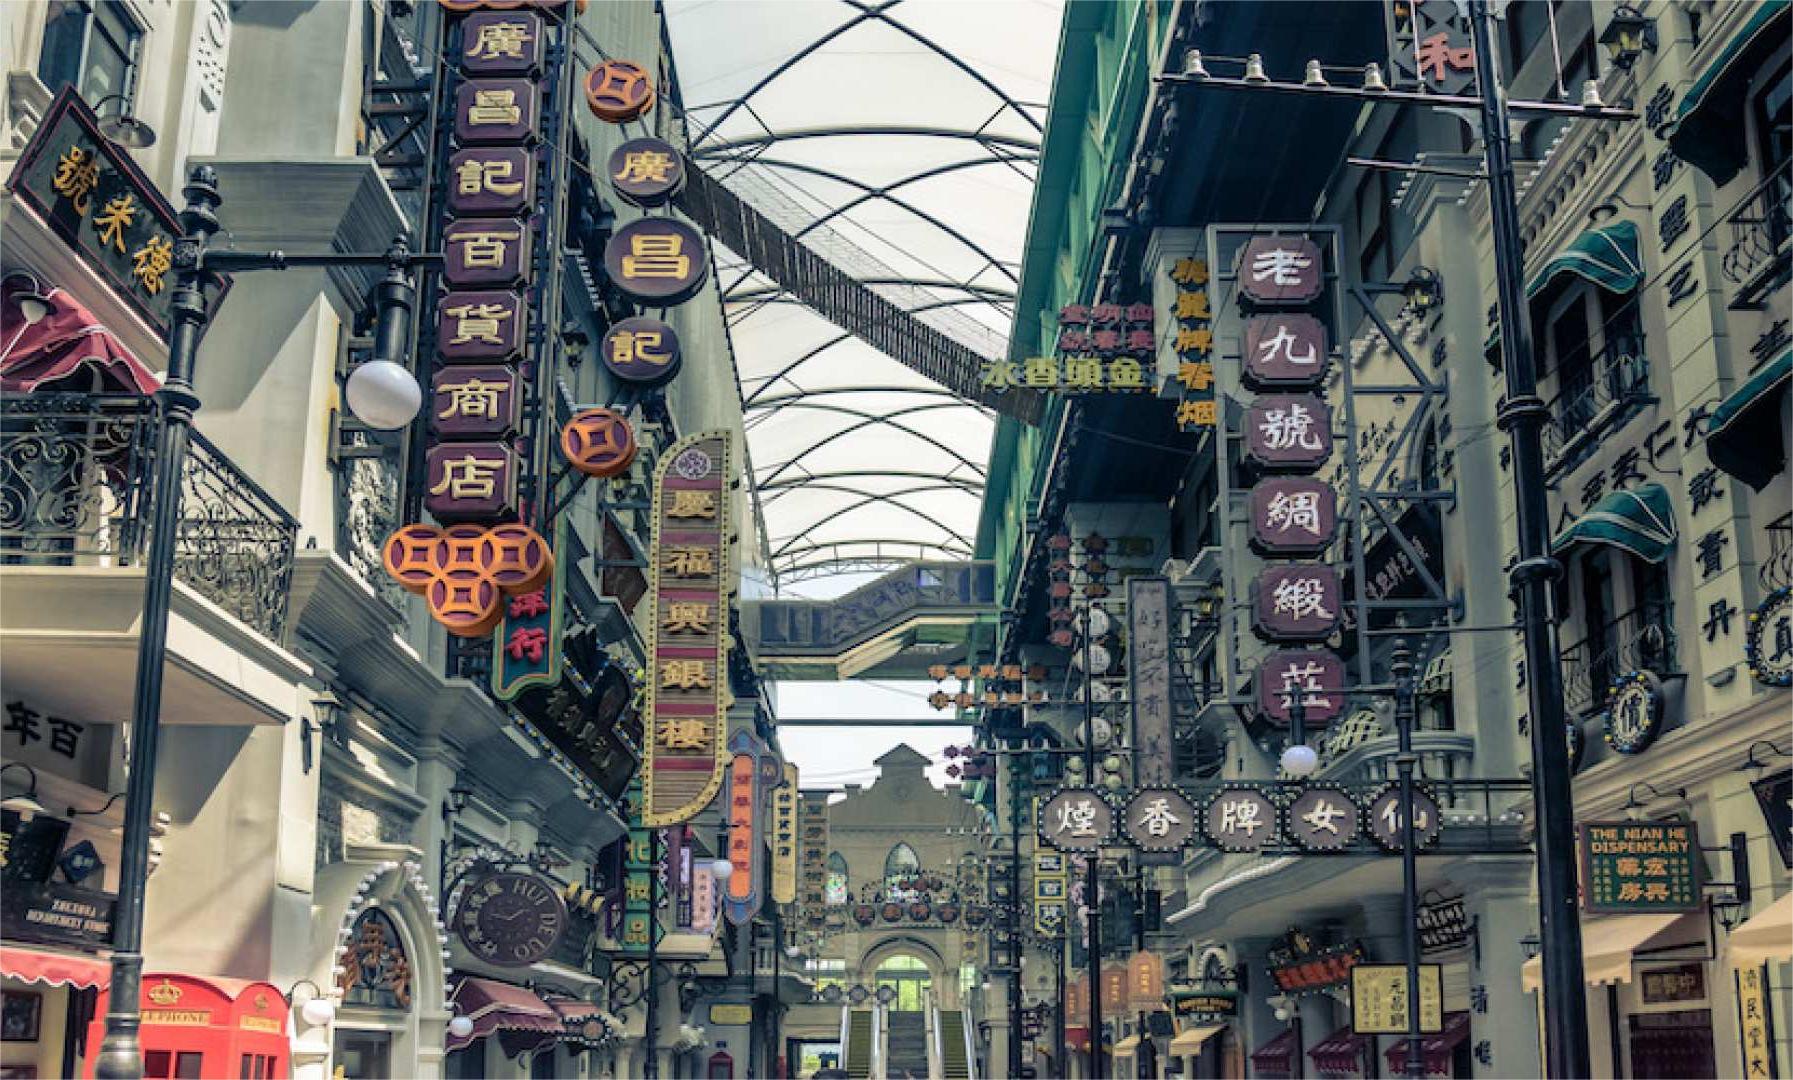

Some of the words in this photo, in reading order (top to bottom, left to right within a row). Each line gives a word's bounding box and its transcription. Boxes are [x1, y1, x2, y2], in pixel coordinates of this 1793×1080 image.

[430, 22, 533, 498] 廣昌記百貨商店
[610, 151, 690, 363] 廣昌記
[1590, 828, 1618, 840] THE
[1591, 840, 1689, 853] DISPENSARY
